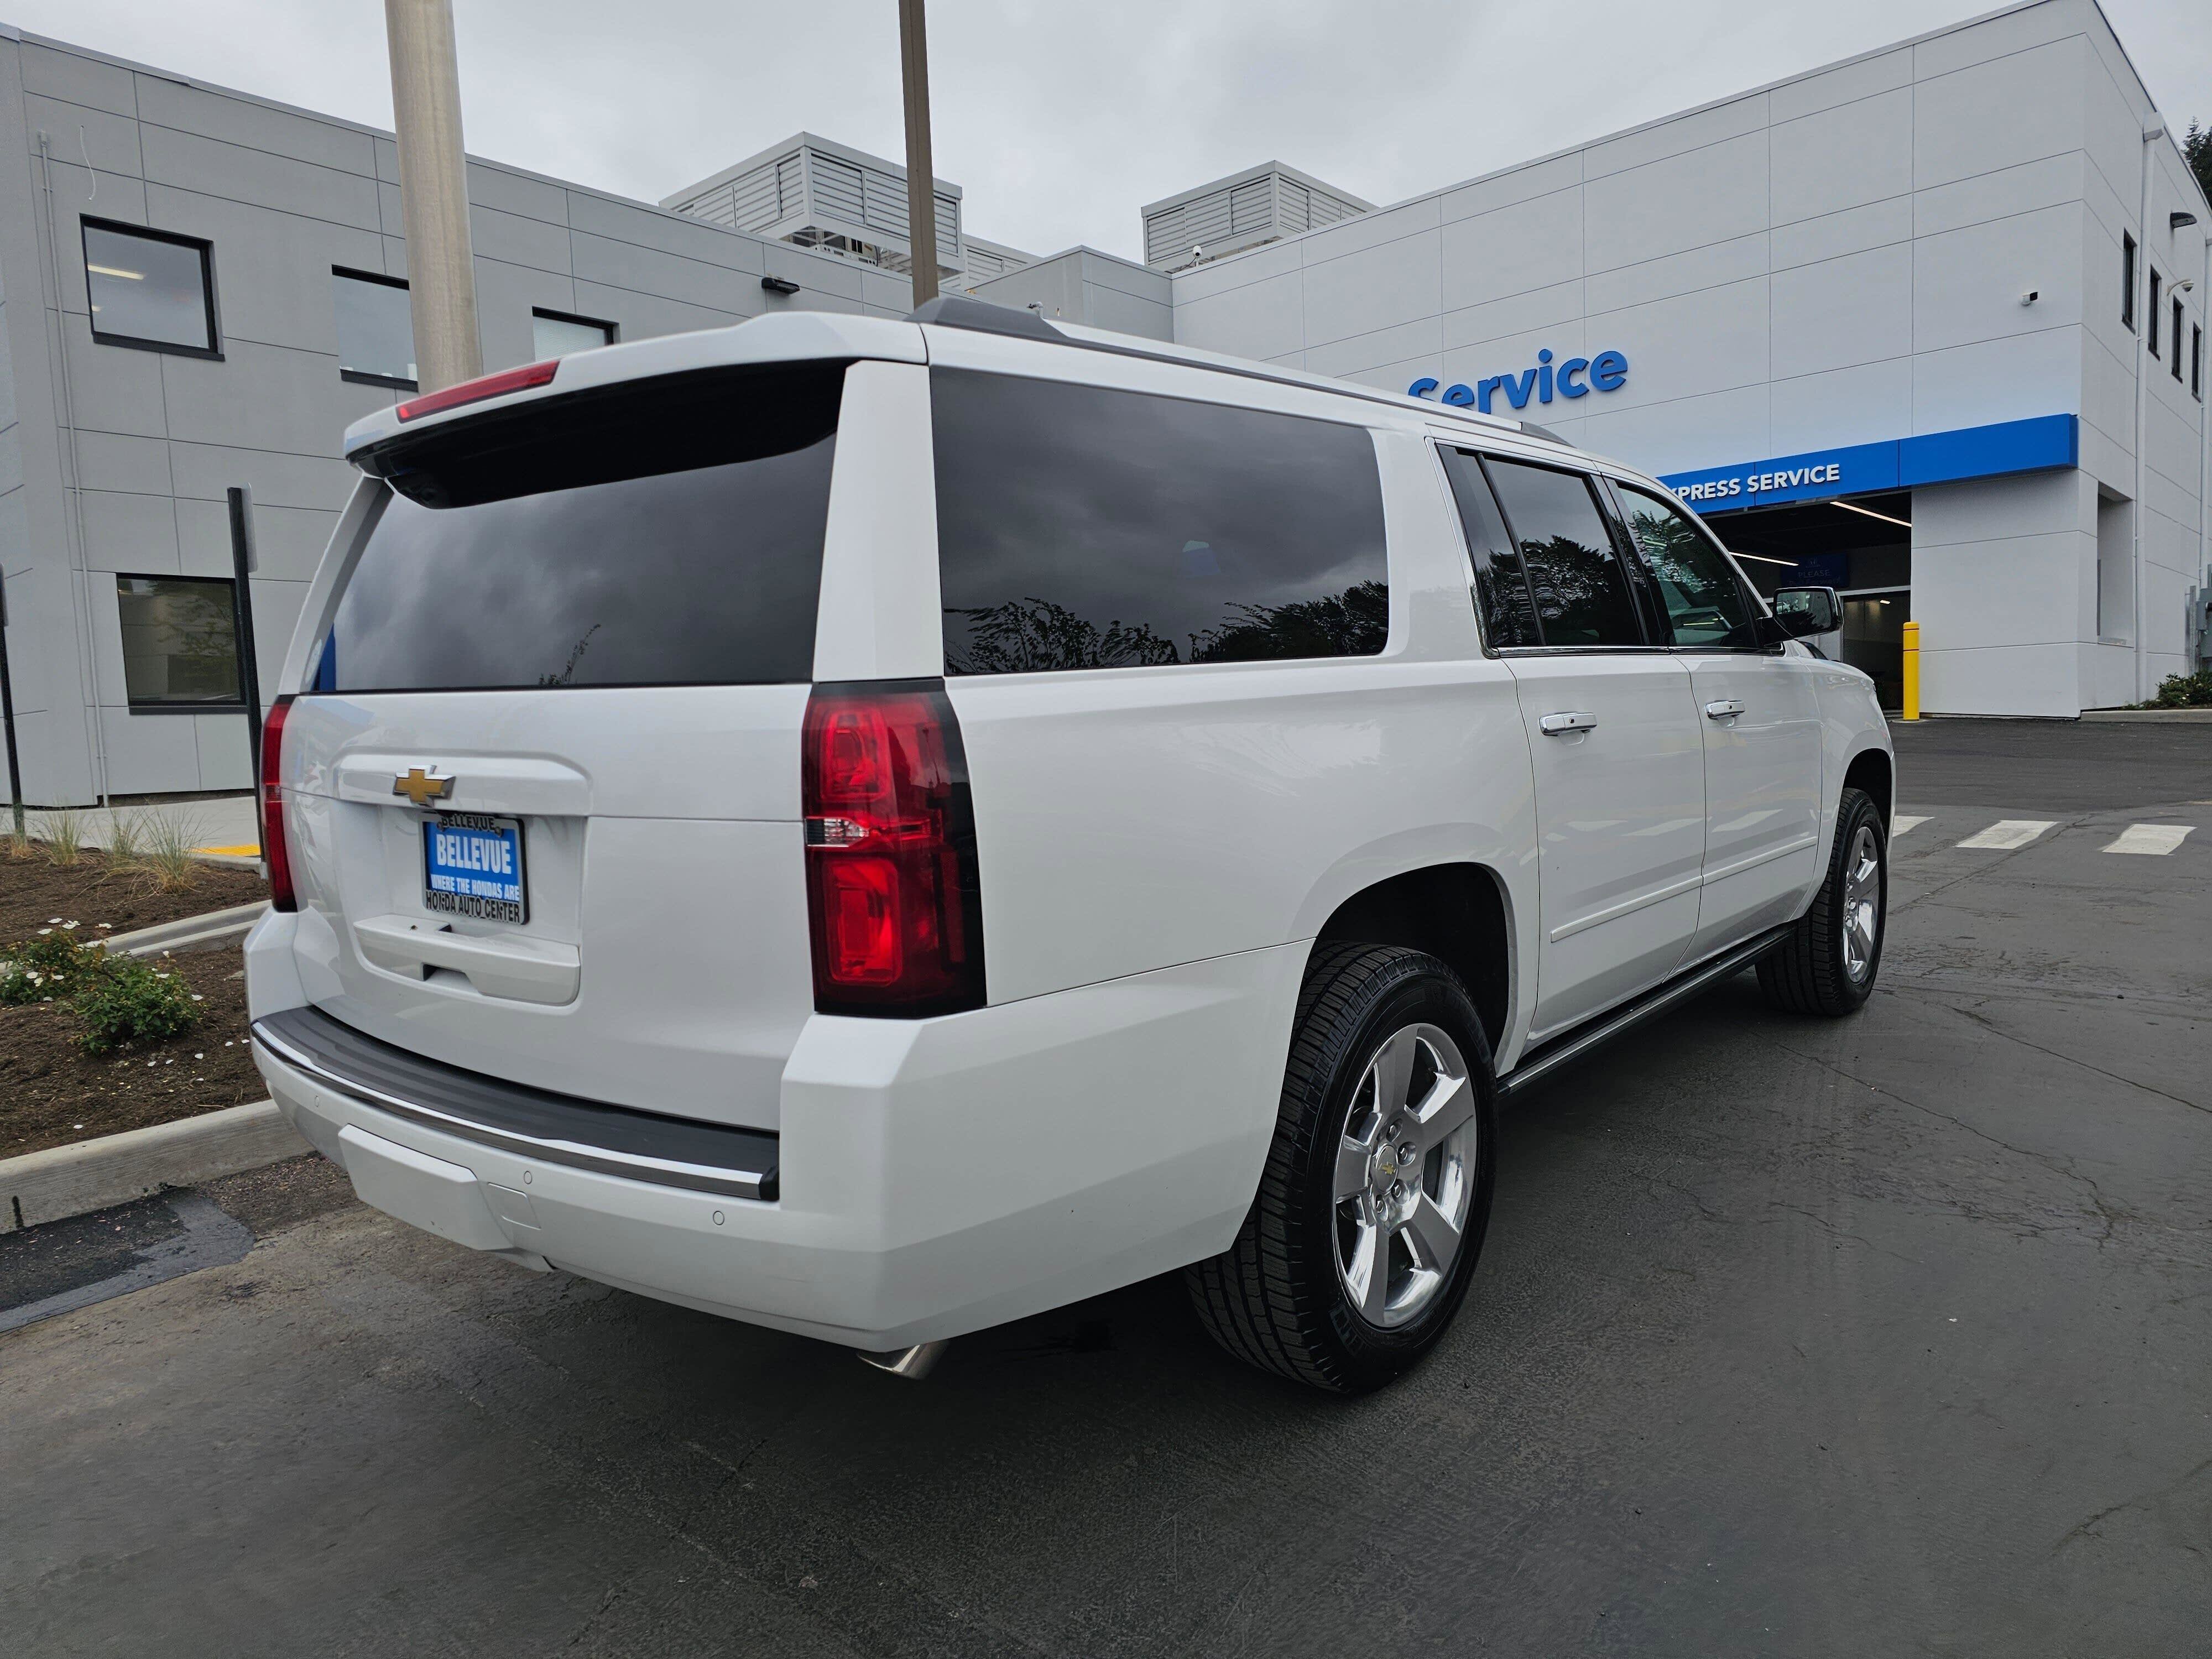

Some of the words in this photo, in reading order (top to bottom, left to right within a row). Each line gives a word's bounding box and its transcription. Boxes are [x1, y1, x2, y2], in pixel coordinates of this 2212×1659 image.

[1747, 464, 1840, 492] SERVICE
[1798, 570, 1830, 578] PLEASE
[442, 815, 494, 831] BELLEVUE
[436, 834, 512, 874] BELLEVUE
[431, 874, 455, 891] WHERE
[457, 878, 470, 894] THE
[472, 880, 502, 899] HONDAS
[504, 885, 520, 901] ARE
[426, 891, 456, 912] HONDA
[458, 896, 482, 917] AUTO
[485, 899, 520, 923] CENTER
